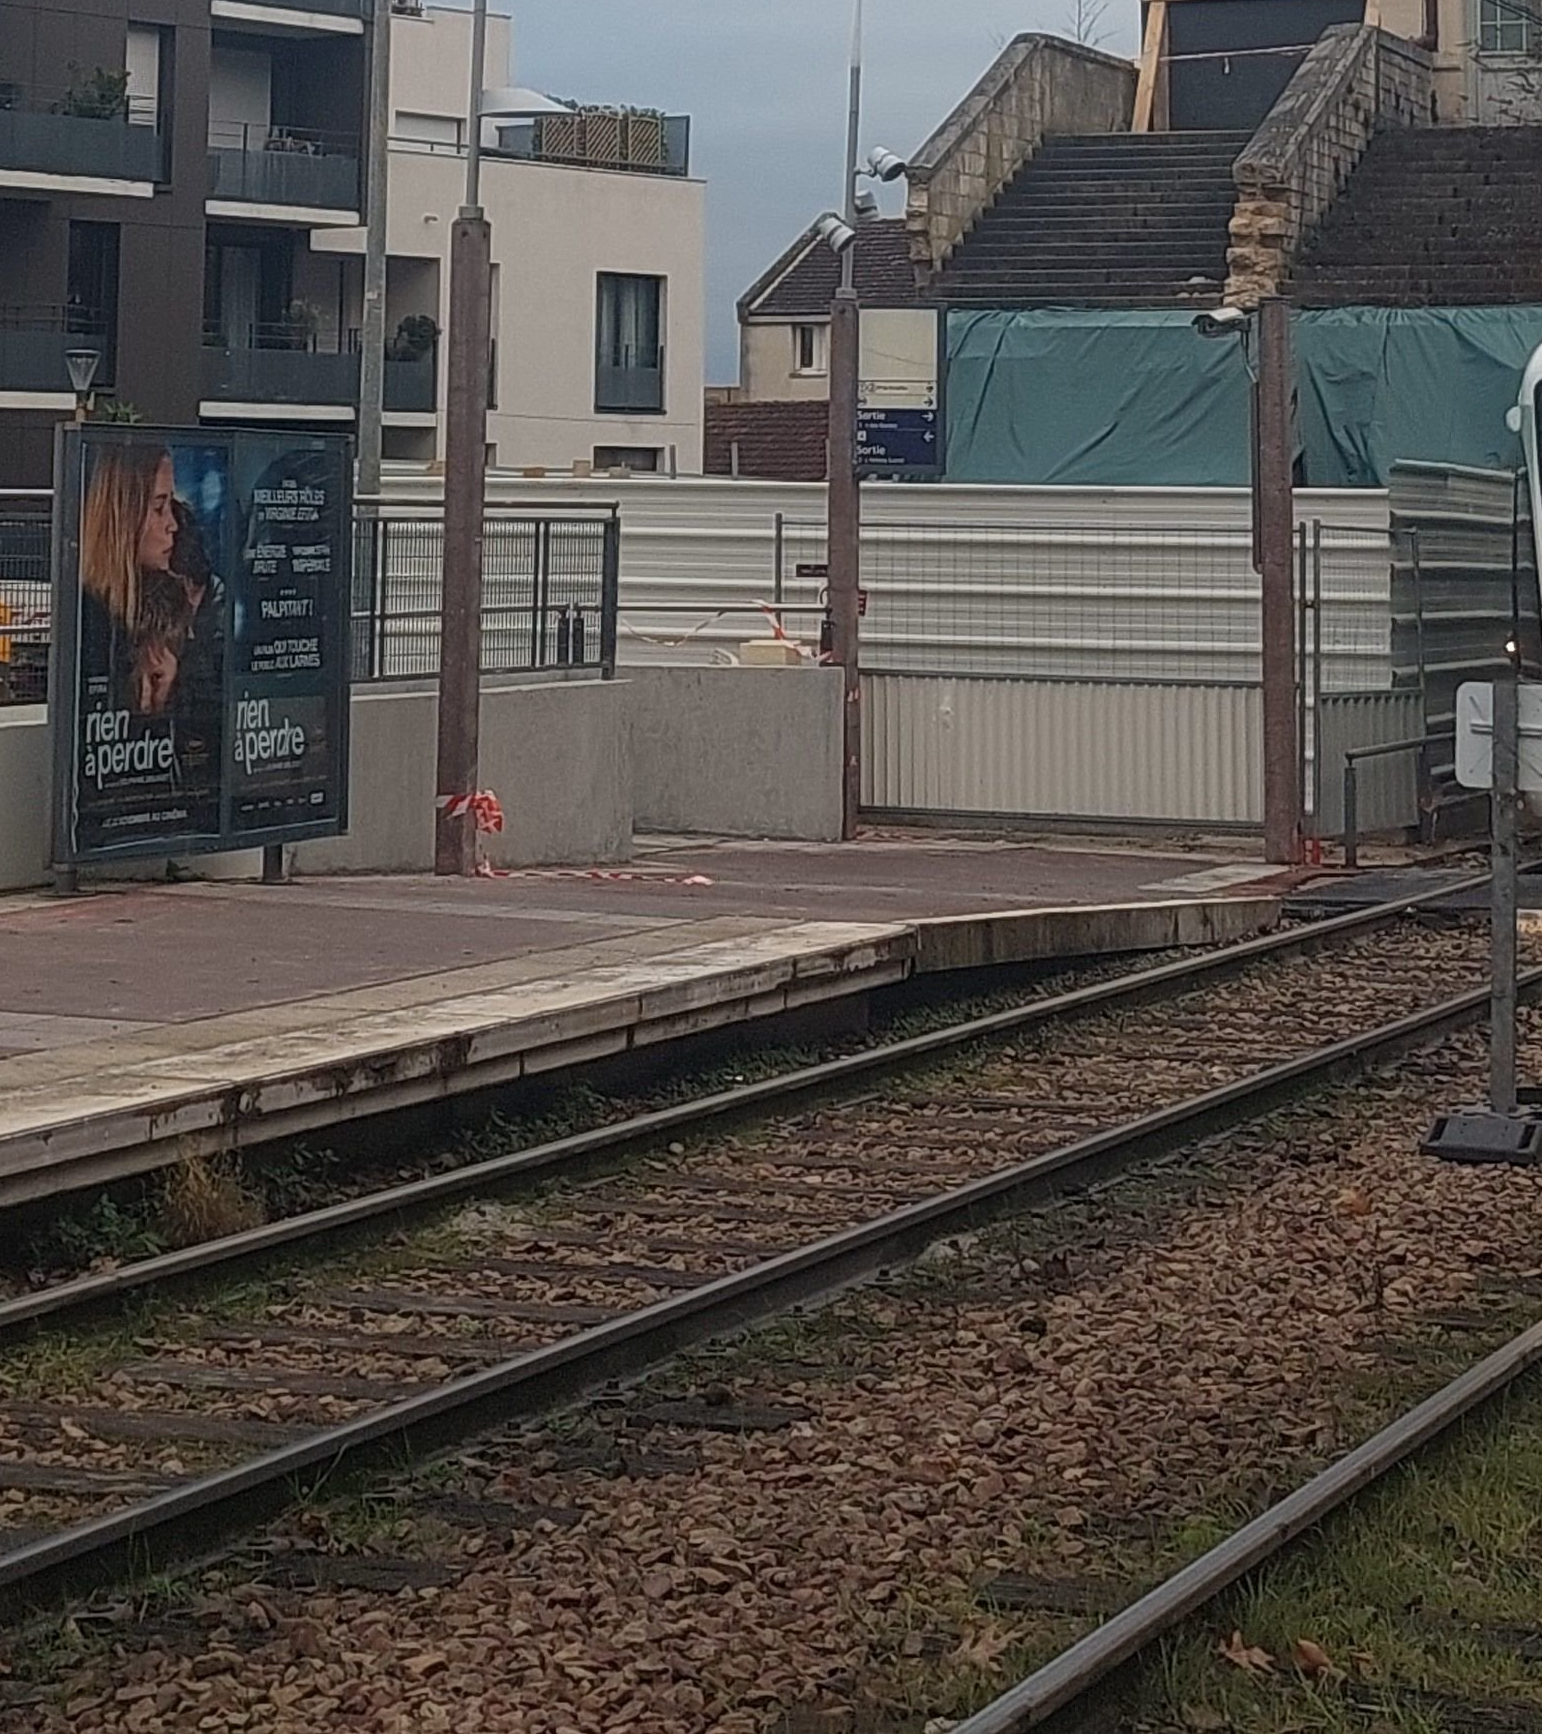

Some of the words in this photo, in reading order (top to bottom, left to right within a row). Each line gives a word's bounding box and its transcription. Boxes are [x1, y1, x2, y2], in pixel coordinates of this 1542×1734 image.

[857, 410, 886, 420] Sortie
[856, 444, 886, 455] Sortie
[254, 489, 297, 504] MEILLEURS
[86, 701, 130, 743] rien
[236, 691, 270, 730] rien
[85, 745, 96, 776] à
[97, 729, 173, 790] perdre
[234, 731, 244, 761] à
[245, 717, 305, 775] perdre
